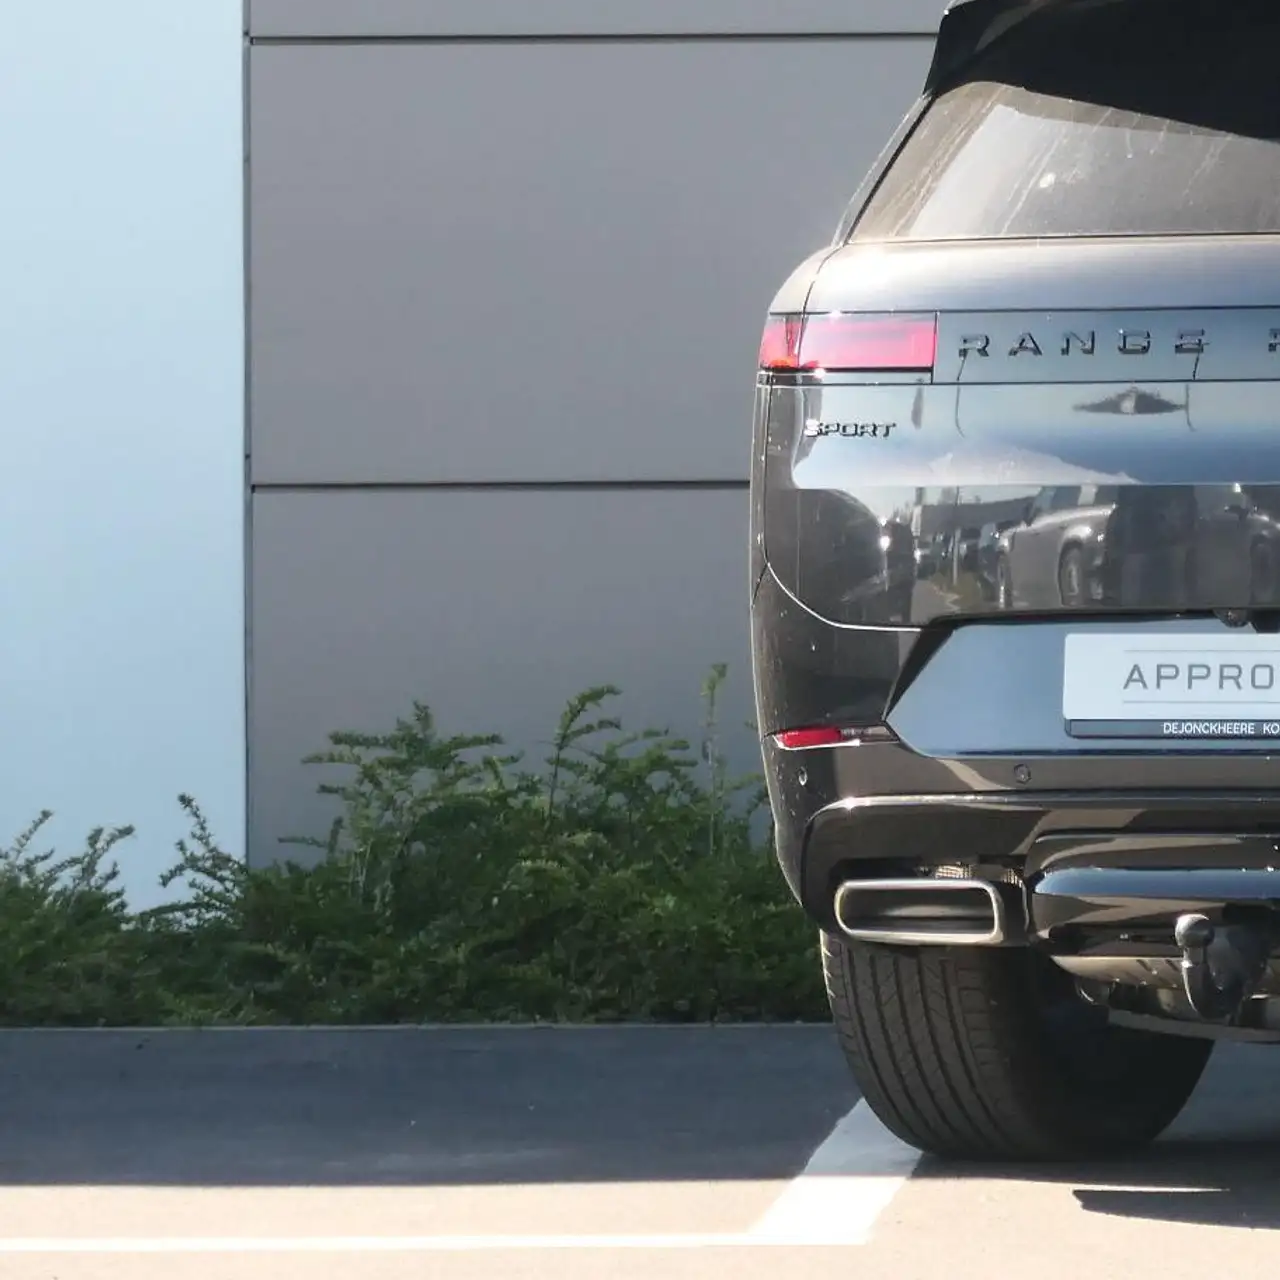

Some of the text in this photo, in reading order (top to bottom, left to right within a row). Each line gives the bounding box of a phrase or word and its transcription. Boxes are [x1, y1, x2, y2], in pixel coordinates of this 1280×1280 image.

[958, 329, 1207, 357] RANGE
[804, 420, 895, 438] SPORT
[1163, 722, 1255, 735] DEJONCKHEERE
